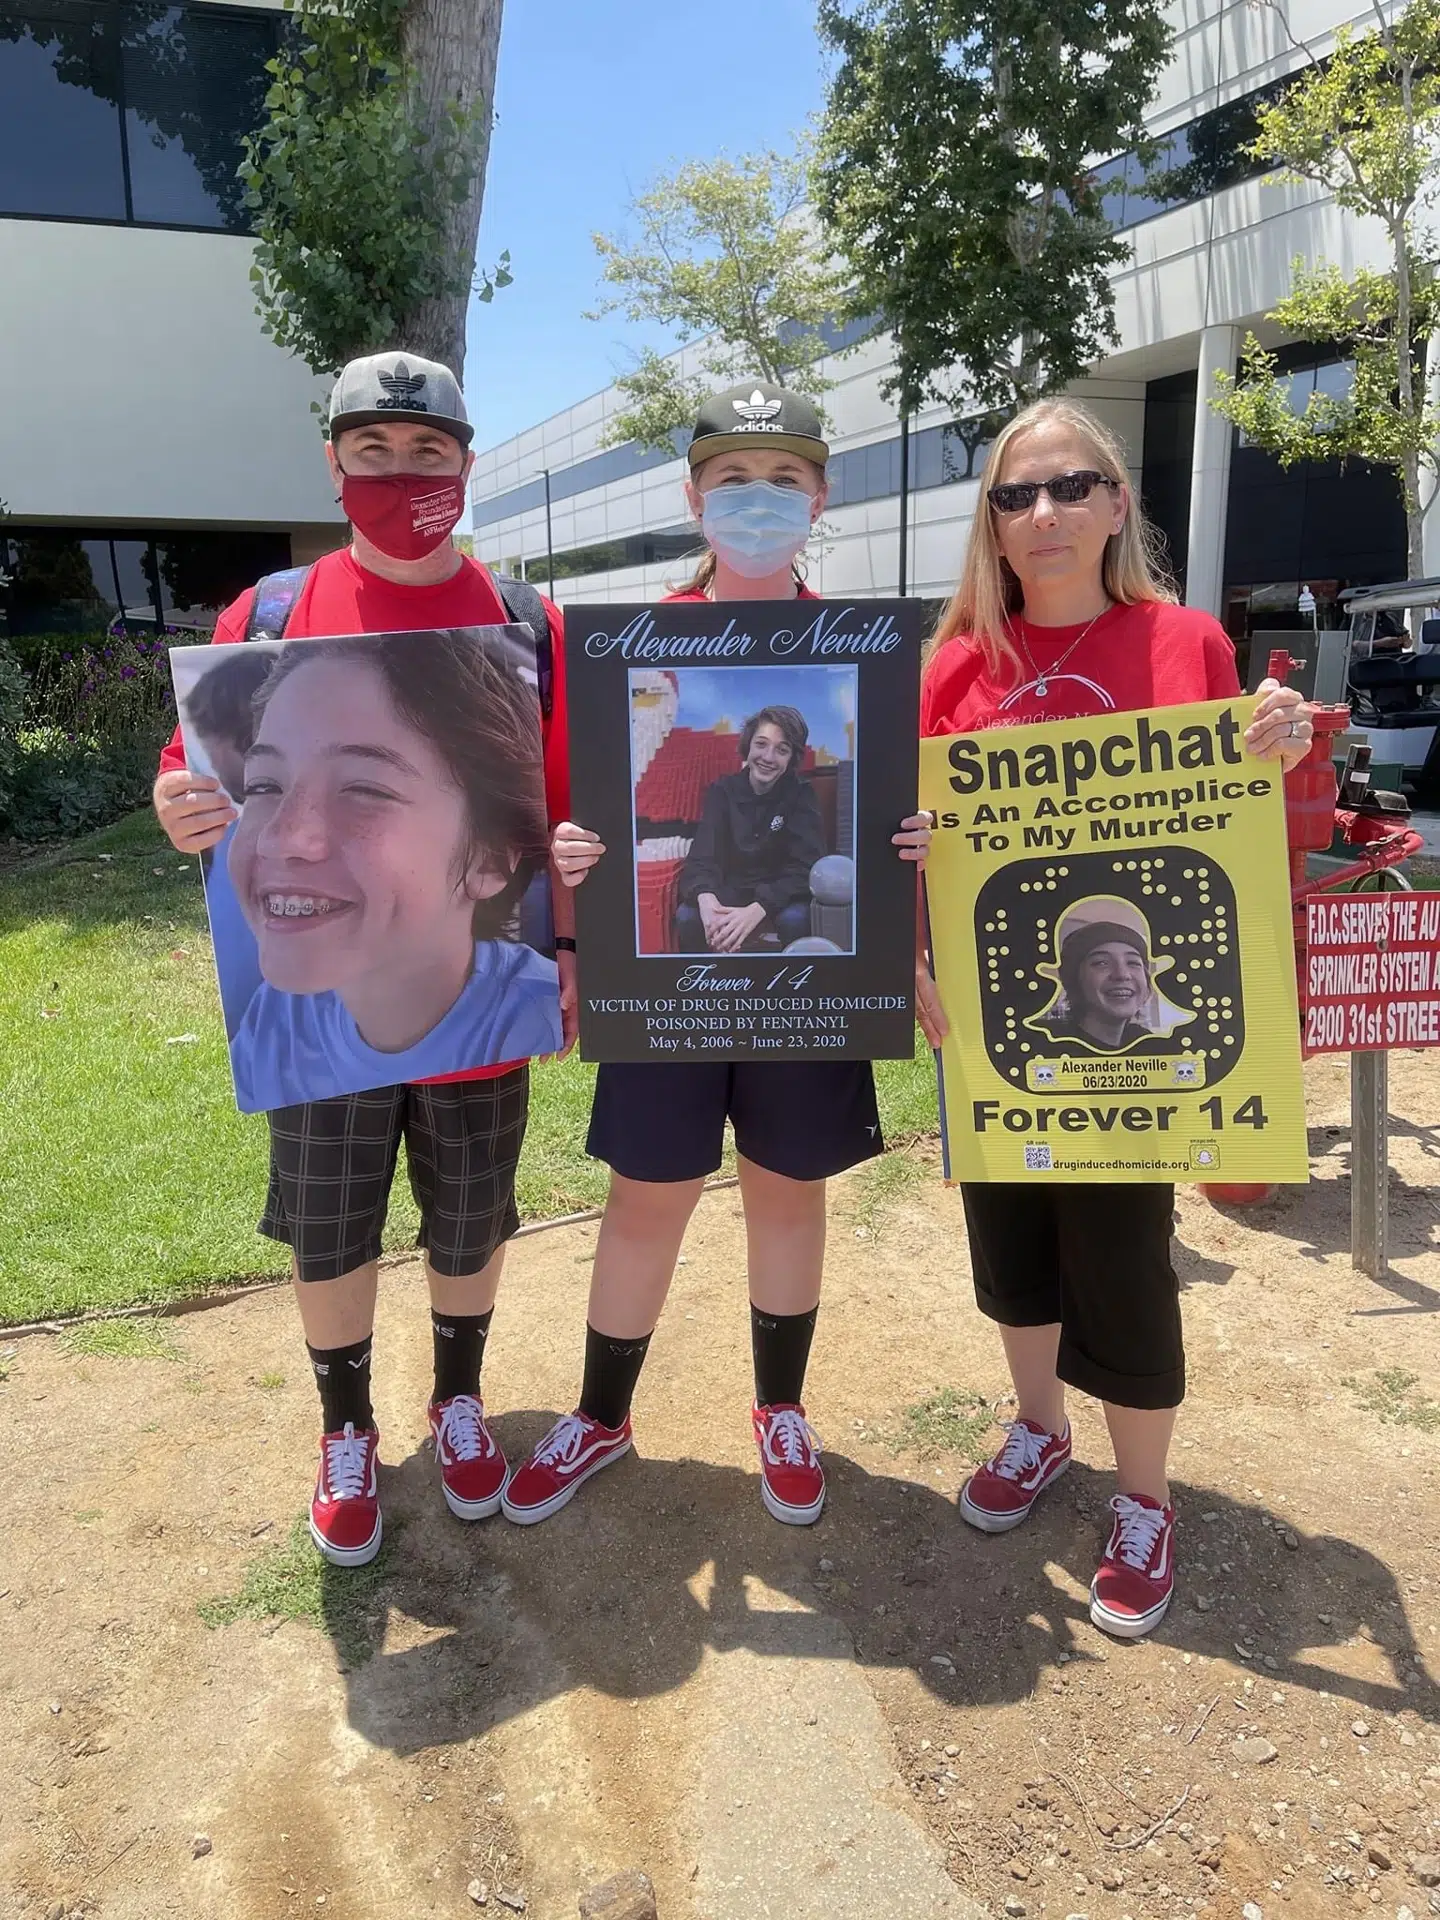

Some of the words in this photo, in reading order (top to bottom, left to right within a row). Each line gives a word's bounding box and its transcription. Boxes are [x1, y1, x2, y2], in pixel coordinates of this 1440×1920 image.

[376, 395, 428, 412] adidas
[732, 420, 783, 432] adidas
[585, 609, 757, 662] Alexander
[770, 607, 901, 656] Neville
[948, 708, 1243, 796] Snapchat
[930, 809, 960, 829] Is
[972, 803, 1020, 826] An
[1034, 778, 1272, 820] Accomplice
[965, 831, 1010, 853] To
[1024, 825, 1076, 851] My
[1090, 811, 1233, 842] Murder
[1393, 901, 1418, 941] THE
[676, 963, 755, 992] Forever
[1309, 954, 1377, 996] SPRINKLER
[1379, 952, 1430, 992] SYSTEM
[588, 999, 650, 1012] VICTIM
[654, 998, 677, 1011] OF
[682, 998, 730, 1011] DRUG
[734, 997, 814, 1011] INDUCED
[818, 996, 907, 1010] HOMICIDE
[646, 1017, 731, 1031] POISONED
[736, 1017, 757, 1029] BY
[762, 1016, 849, 1029] FENTANYL
[1307, 1005, 1345, 1047] 2900
[1349, 1003, 1382, 1045] 31st
[1386, 1001, 1440, 1044] STREE
[649, 1036, 680, 1052] May
[682, 1036, 696, 1050] 4,
[700, 1036, 733, 1048] 2006
[751, 1035, 783, 1049] June
[787, 1035, 808, 1050] 23,
[812, 1035, 846, 1048] 2020
[1061, 1060, 1122, 1075] Alexander
[1125, 1058, 1168, 1073] Neville
[1082, 1075, 1148, 1089] 06/23/2020
[972, 1099, 1178, 1133] Forever
[1198, 1095, 1269, 1131] 14
[1052, 1159, 1190, 1172] druginducedhomicide.org
